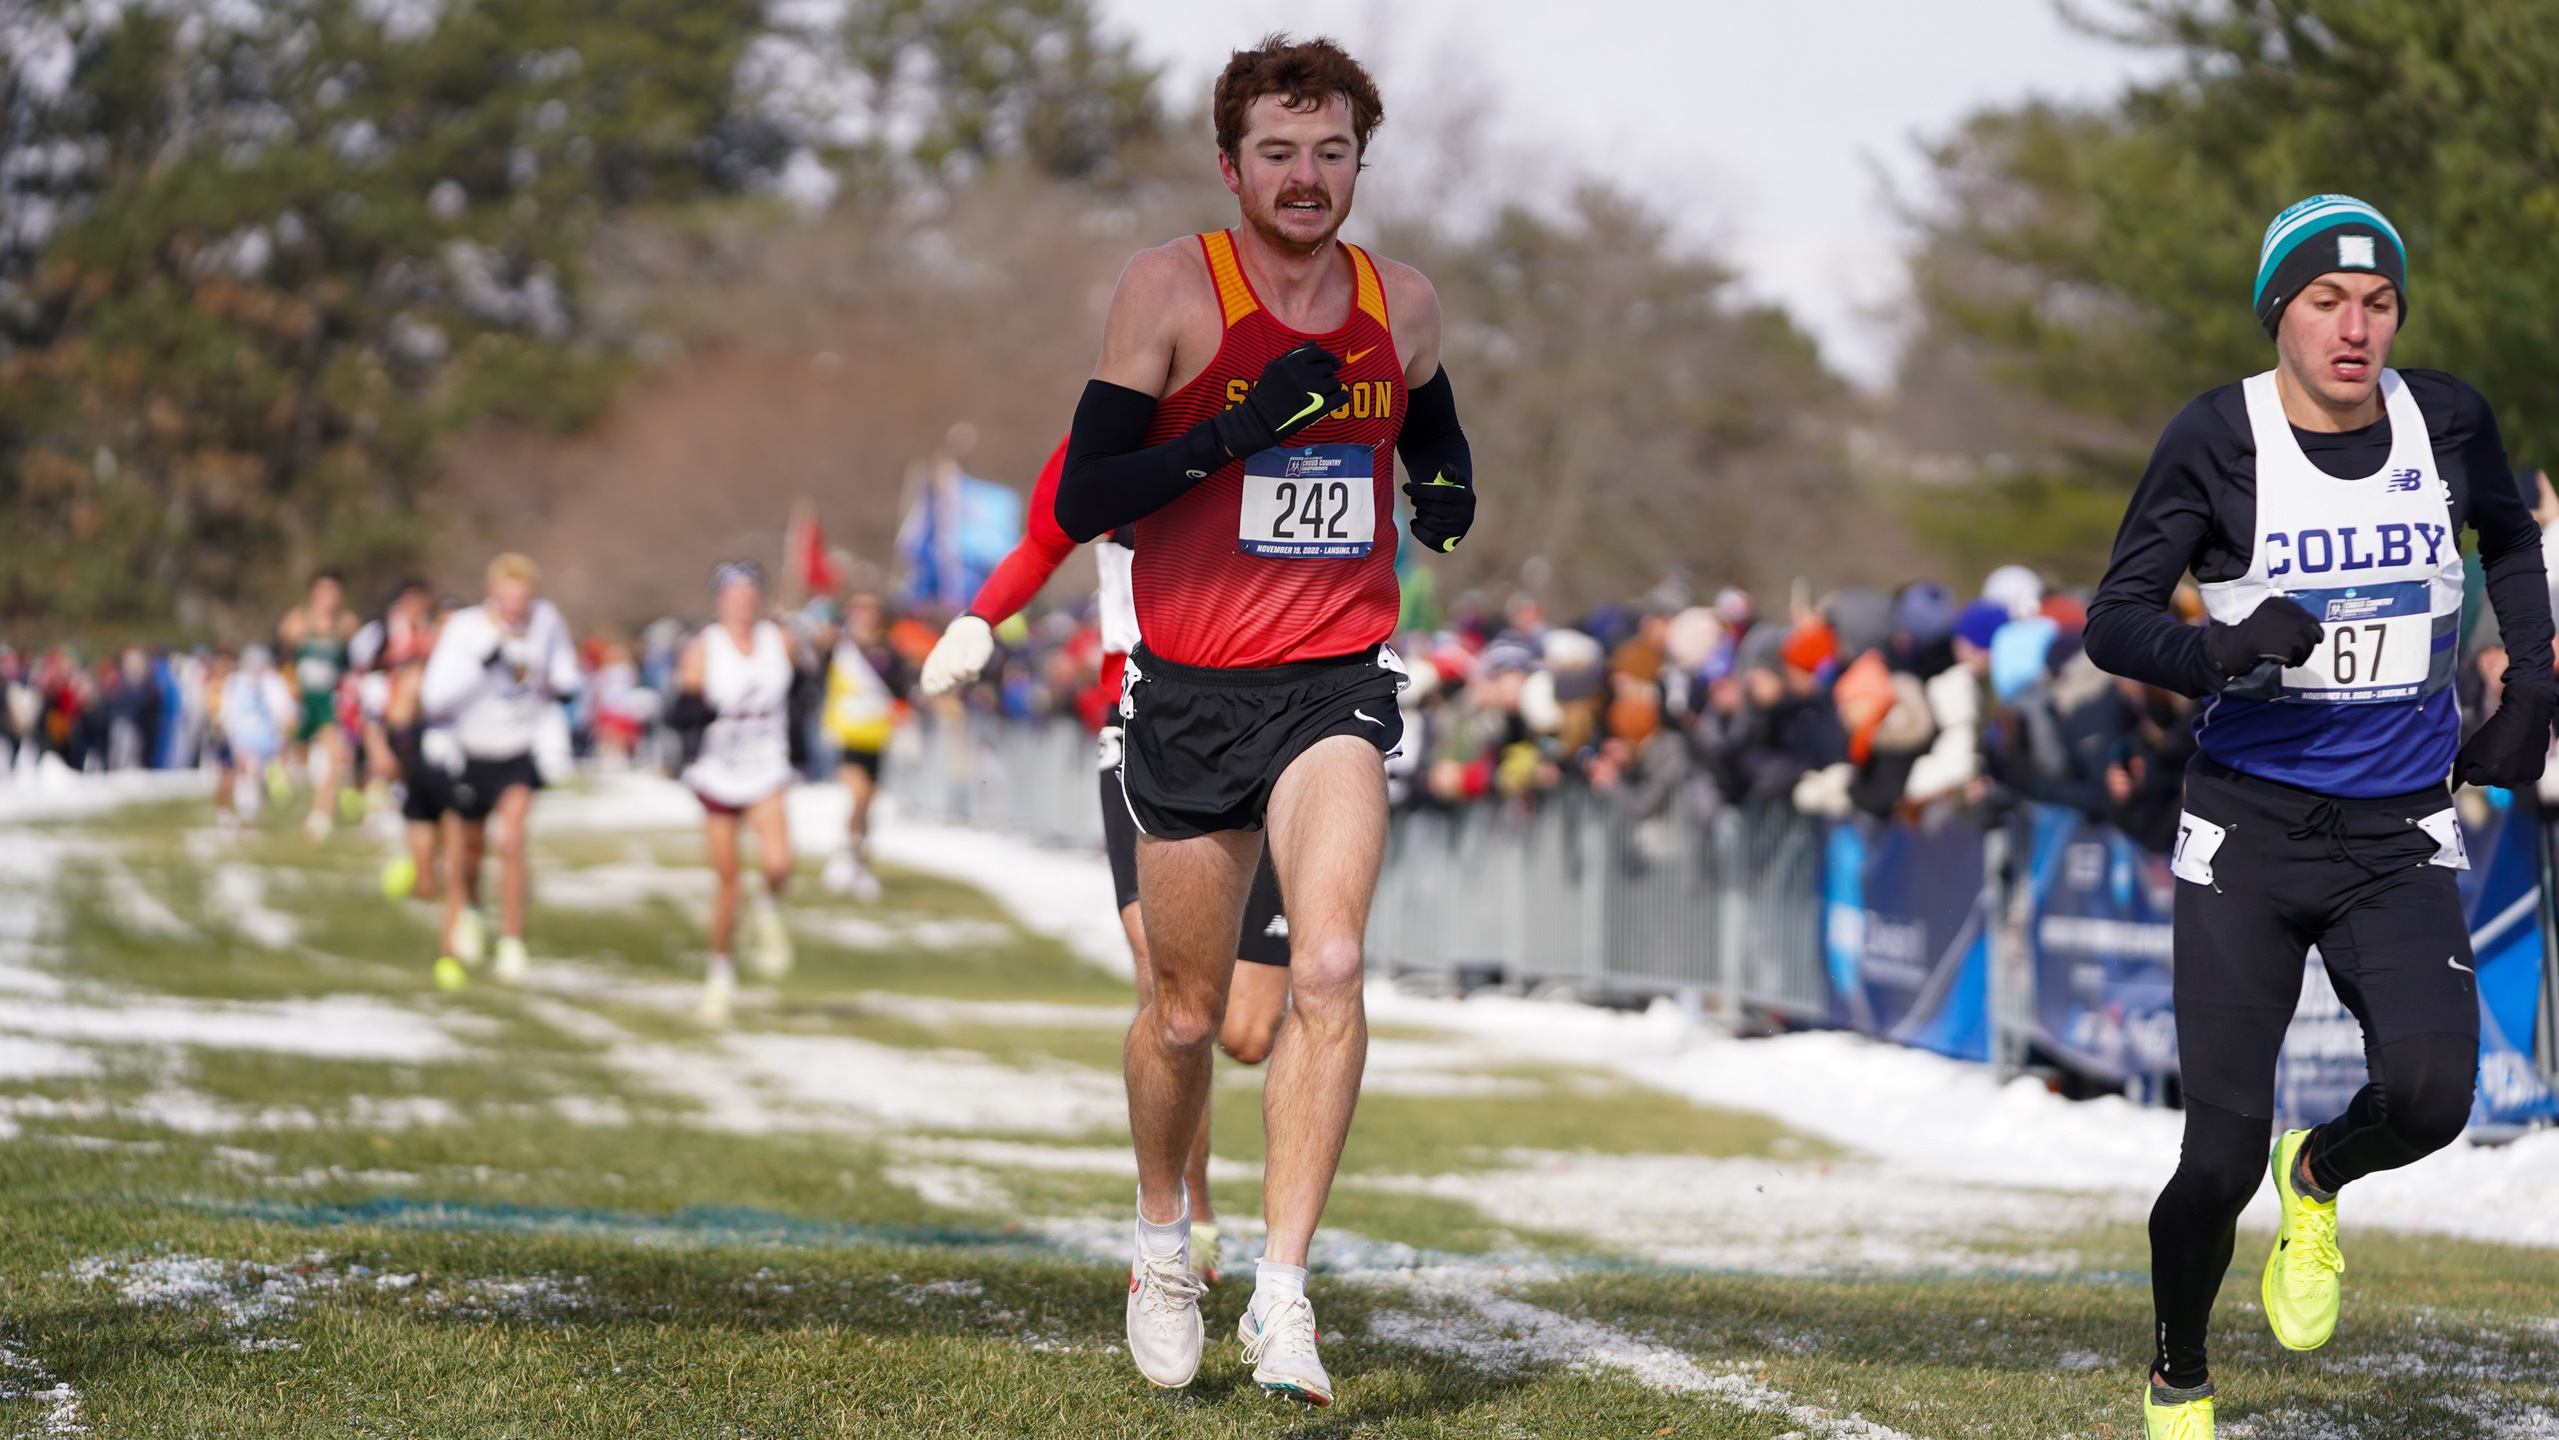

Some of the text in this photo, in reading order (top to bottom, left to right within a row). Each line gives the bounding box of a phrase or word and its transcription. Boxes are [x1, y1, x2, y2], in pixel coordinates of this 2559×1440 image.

[1272, 481, 1349, 539] 242
[1256, 544, 1293, 554] NOVEMBER
[1293, 546, 1302, 555] 19,
[1302, 546, 1320, 555] 2022
[2265, 522, 2446, 579] COLBY
[2333, 623, 2387, 685] 67
[2174, 825, 2193, 862] 7
